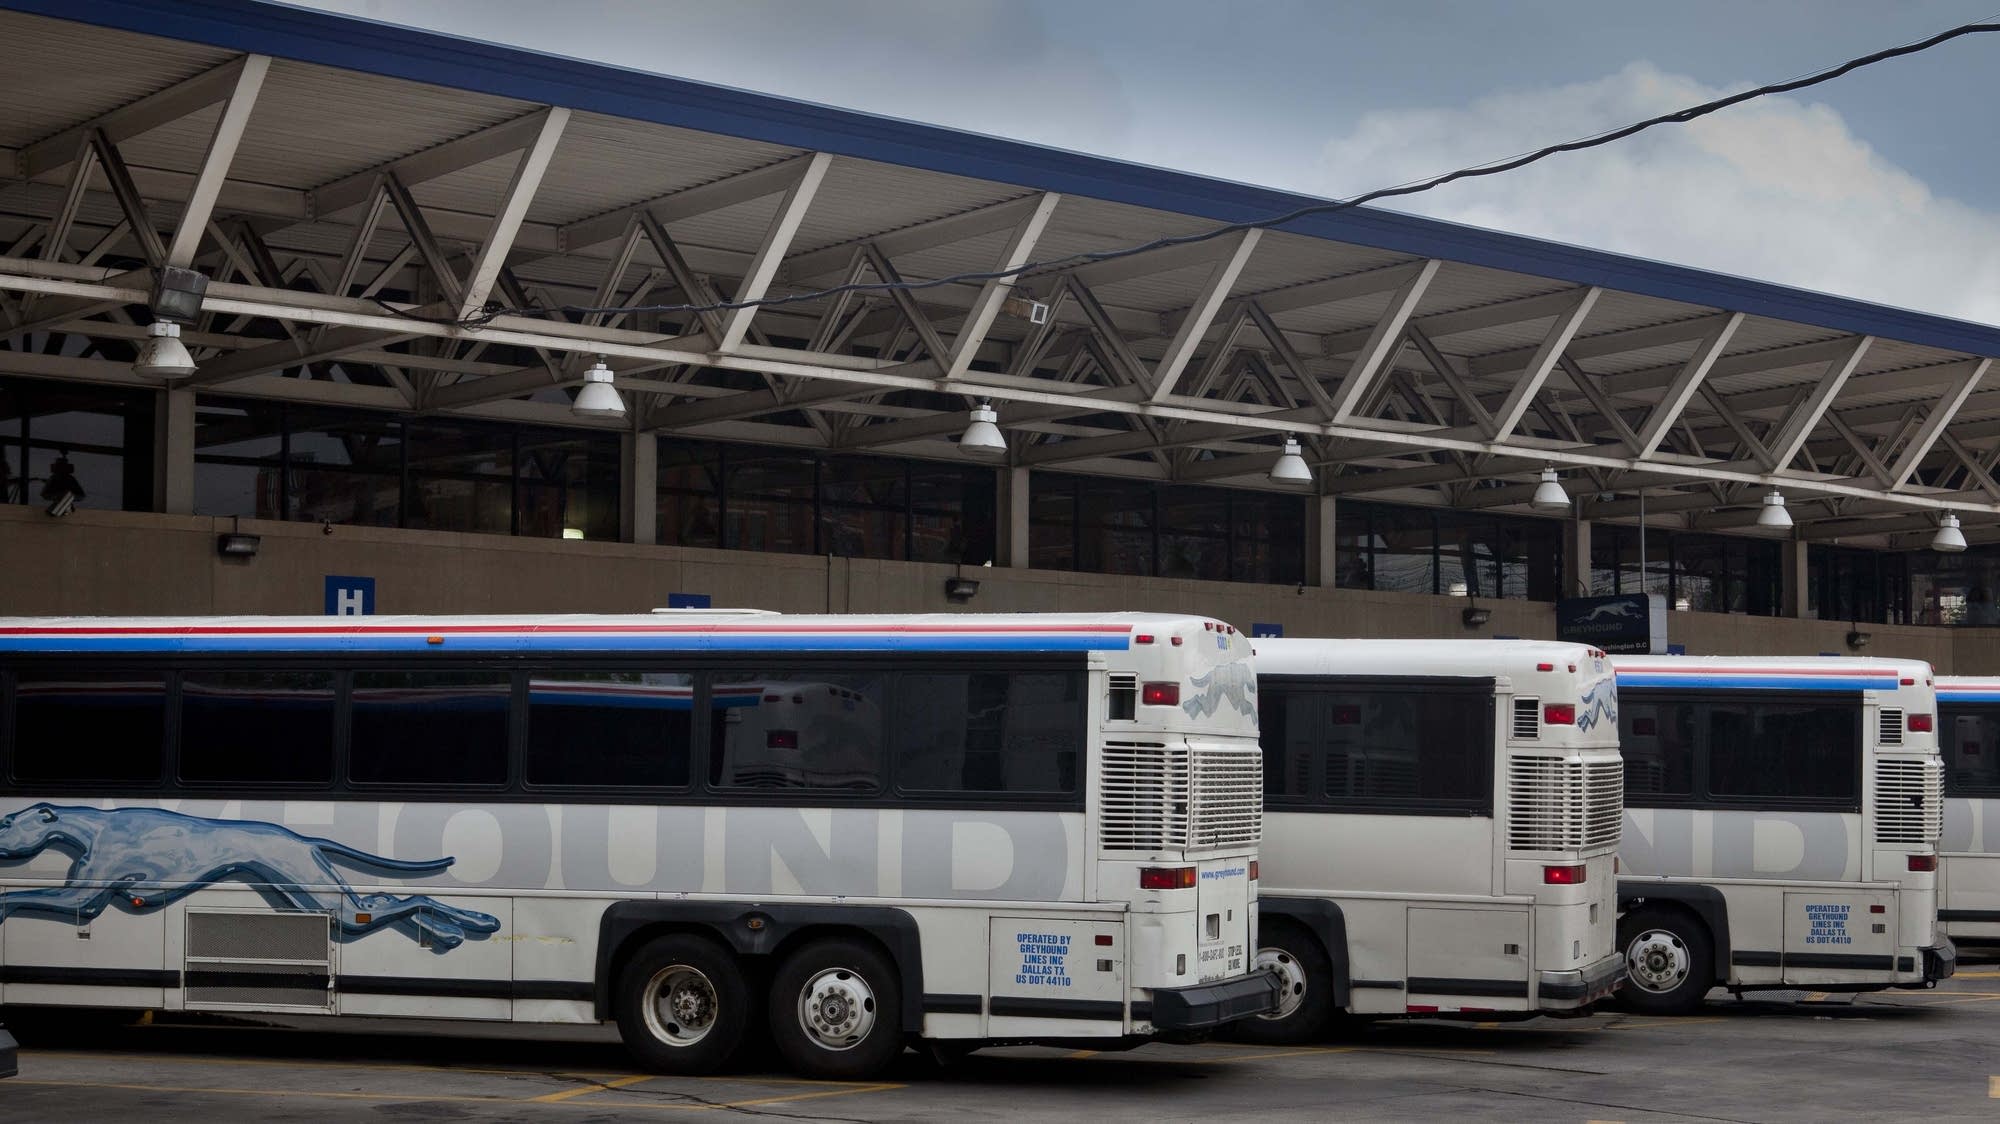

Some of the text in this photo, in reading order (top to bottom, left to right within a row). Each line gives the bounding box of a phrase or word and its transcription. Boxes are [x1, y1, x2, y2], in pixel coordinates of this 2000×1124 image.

[337, 588, 363, 616] H
[1562, 622, 1623, 634] GREYHOUND
[0, 797, 1069, 899] HOUND
[1017, 934, 1071, 945] OPERATED BY
[1020, 944, 1068, 955] GREYHOUND
[1024, 955, 1063, 965] LINES INC
[1022, 965, 1064, 975] DALLAS TX
[1016, 975, 1071, 987] US DOT 44110
